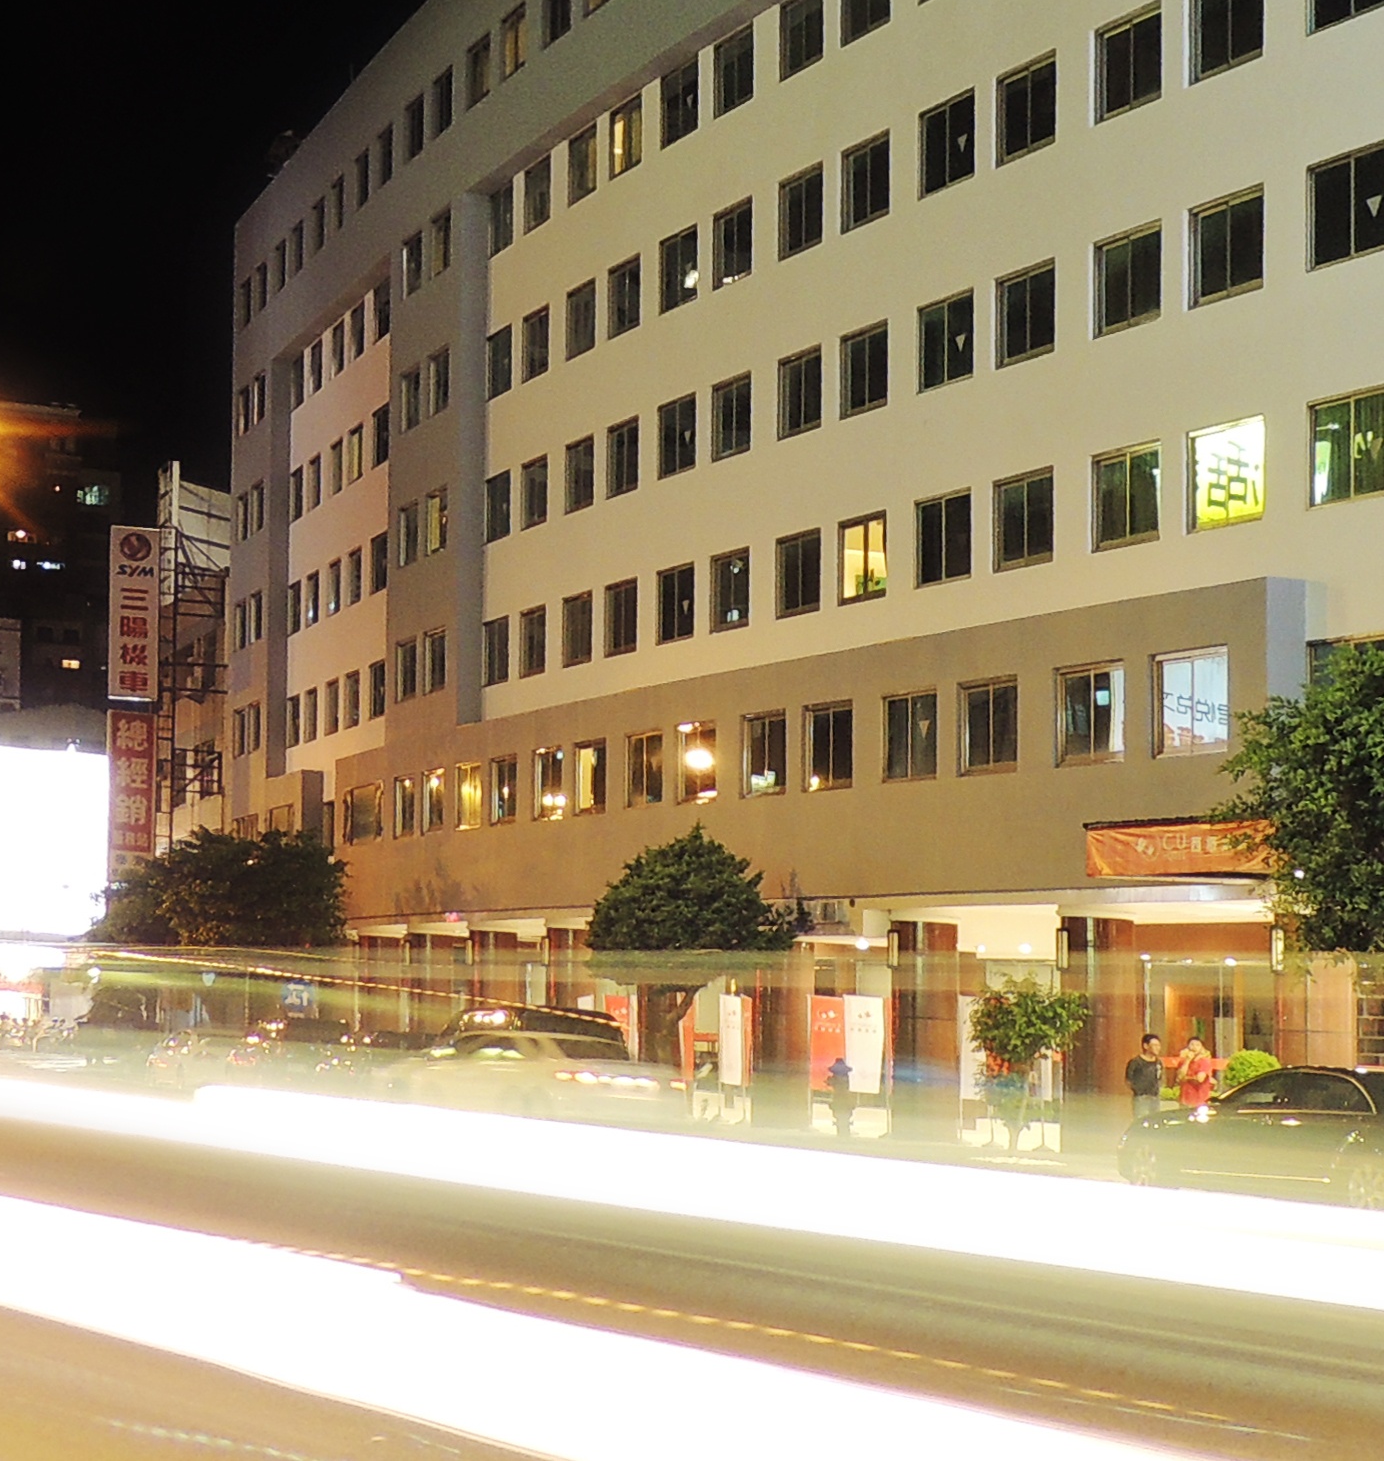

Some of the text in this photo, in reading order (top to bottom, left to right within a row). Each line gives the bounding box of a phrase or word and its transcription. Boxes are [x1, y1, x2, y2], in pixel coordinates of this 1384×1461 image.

[115, 563, 155, 578] SYM
[115, 718, 149, 826] 總經銷
